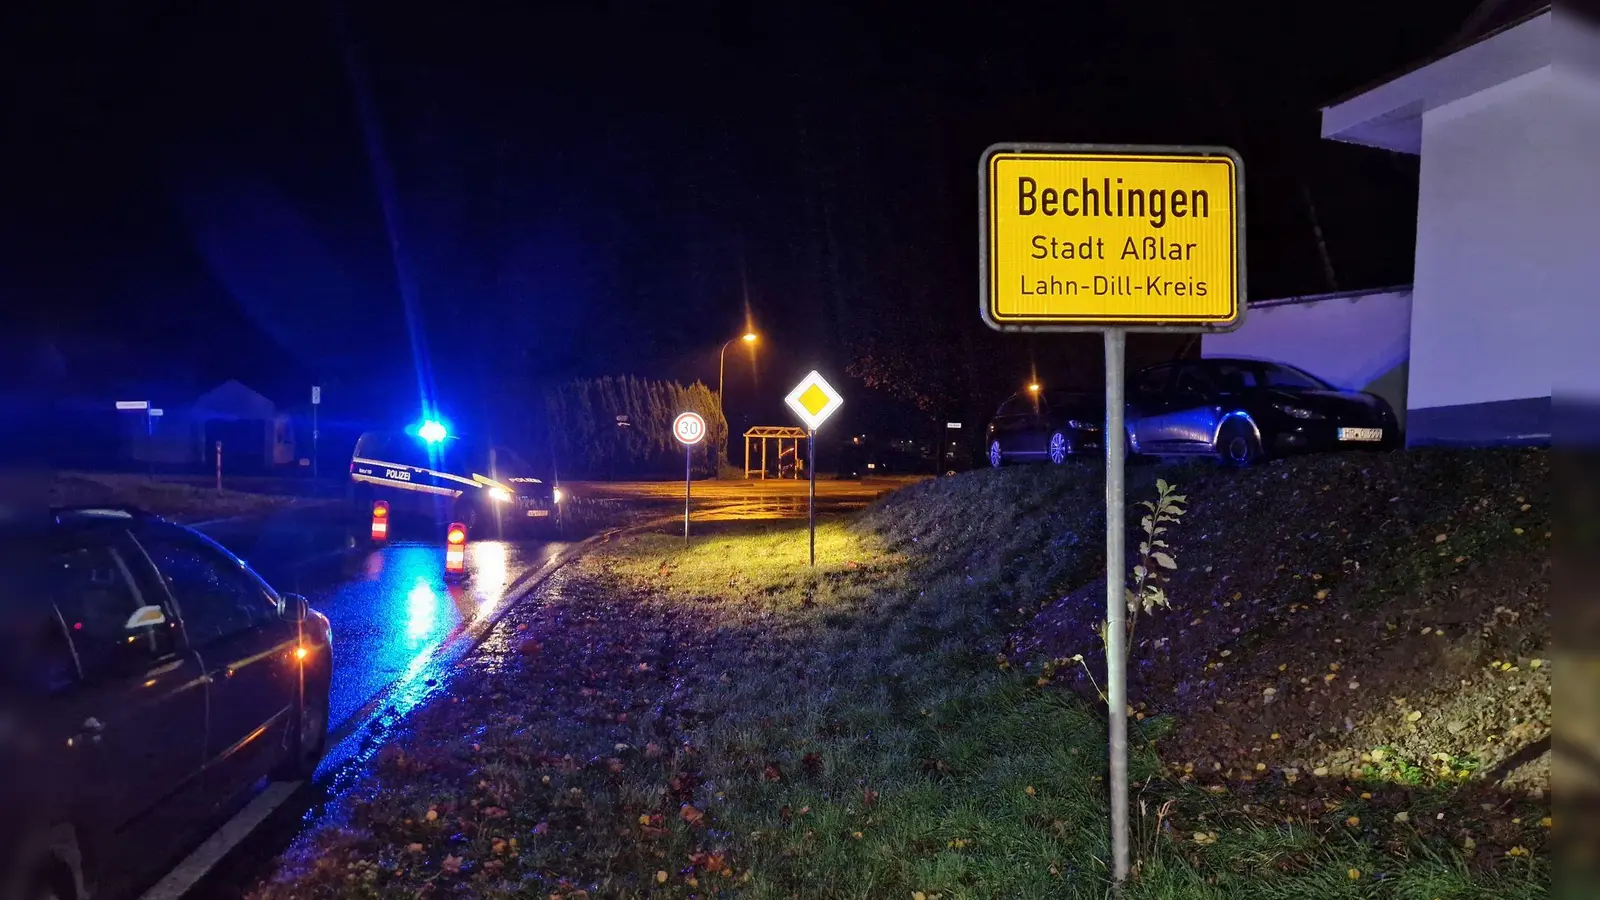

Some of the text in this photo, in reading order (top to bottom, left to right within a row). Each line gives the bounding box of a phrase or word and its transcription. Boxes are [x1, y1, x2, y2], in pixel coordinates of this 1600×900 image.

[1018, 176, 1209, 229] Bechlingen
[1031, 235, 1197, 261] Stadt Aßlar
[1021, 275, 1208, 297] Lahn-Dill-Kreis
[680, 421, 698, 435] 30
[385, 469, 411, 481] POLIZEI
